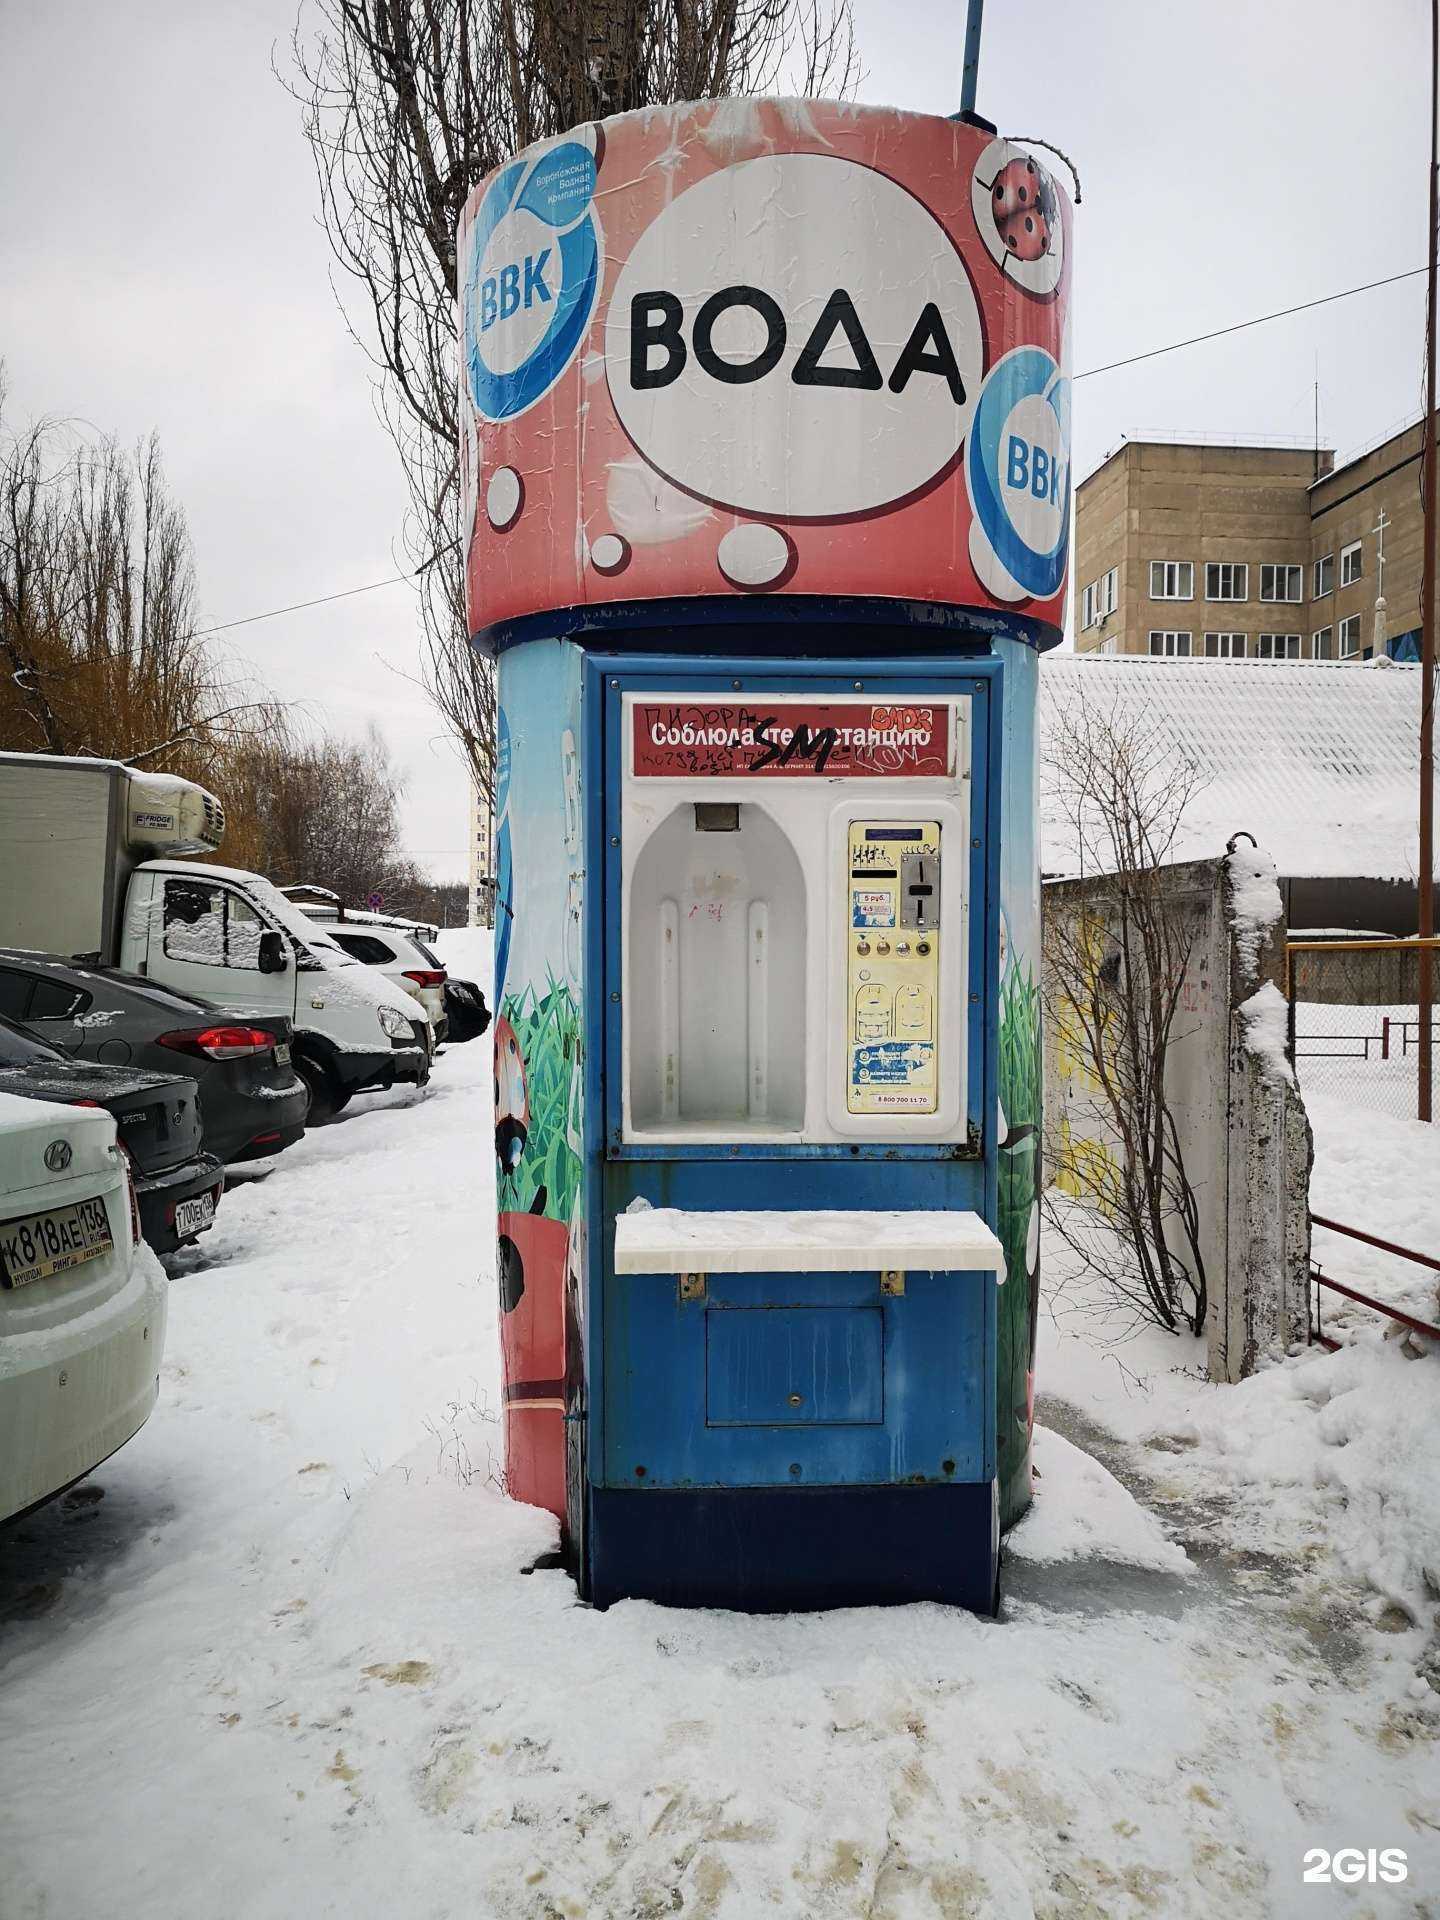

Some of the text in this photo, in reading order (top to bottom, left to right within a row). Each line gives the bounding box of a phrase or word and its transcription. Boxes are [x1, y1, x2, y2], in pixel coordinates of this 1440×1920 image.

[480, 248, 552, 332] ВВК
[630, 285, 967, 405] ВОДА
[144, 815, 171, 823] FRIDGE
[896, 1096, 908, 1104] 700
[80, 1202, 106, 1233] 136
